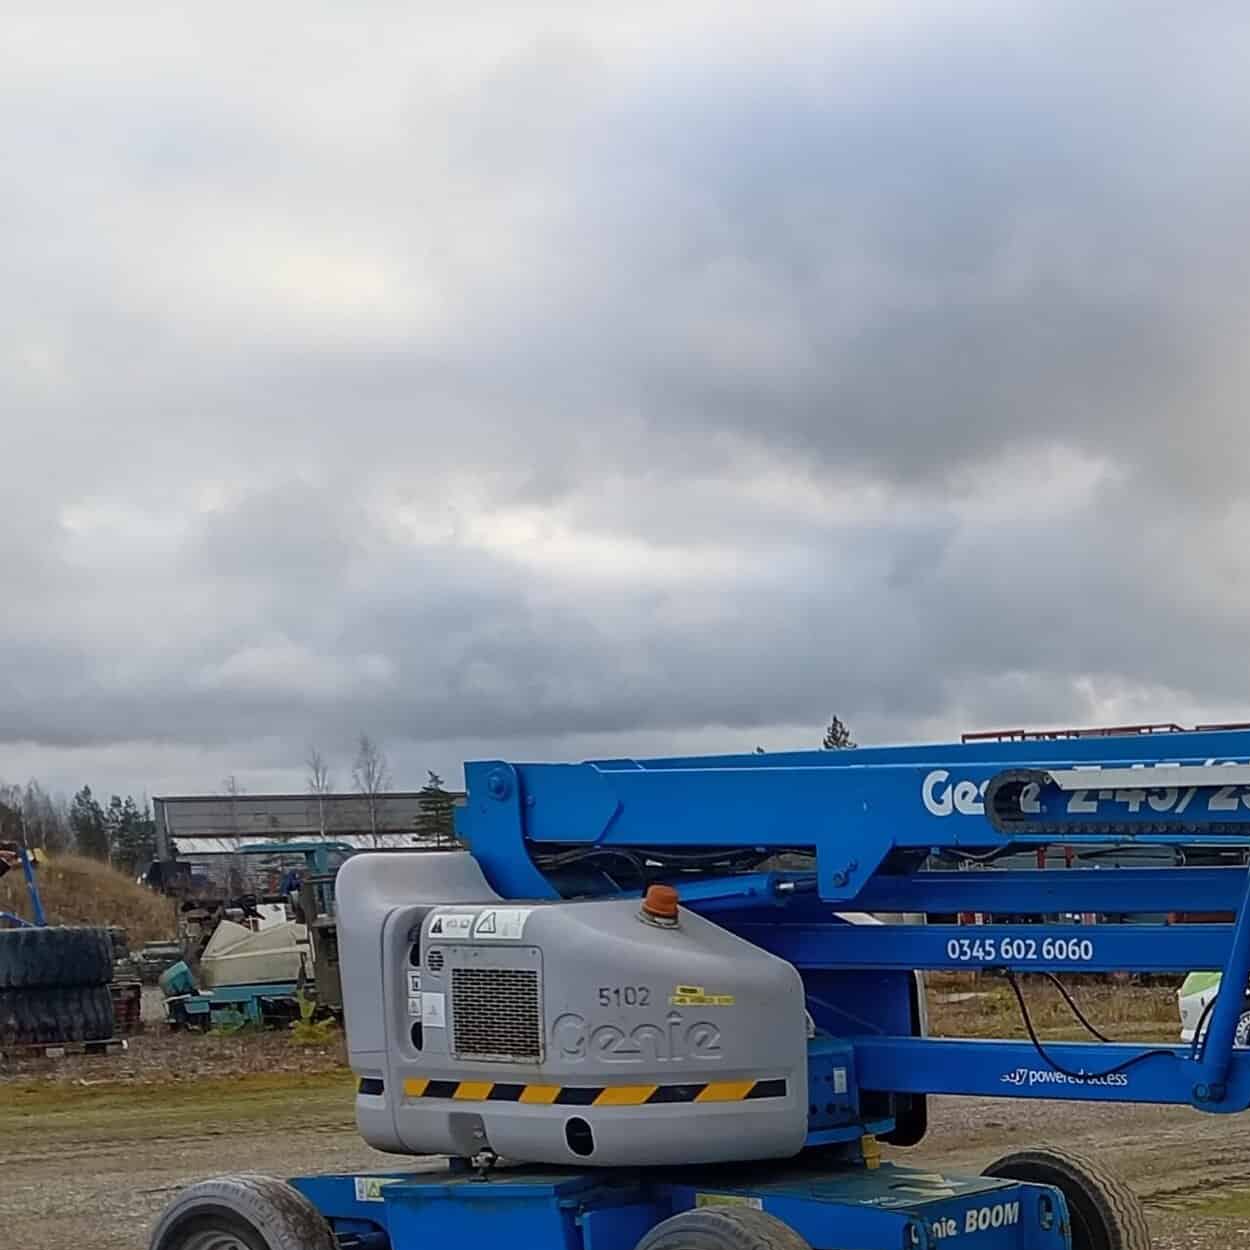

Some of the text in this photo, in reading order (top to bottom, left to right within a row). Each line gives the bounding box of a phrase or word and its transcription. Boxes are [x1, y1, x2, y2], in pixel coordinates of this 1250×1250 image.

[922, 769, 1041, 817] Gee
[947, 938, 1093, 961] 0345 602 6060
[598, 986, 650, 1007] 5102
[551, 1010, 723, 1064] Genie
[965, 1200, 1020, 1233] BOOM
